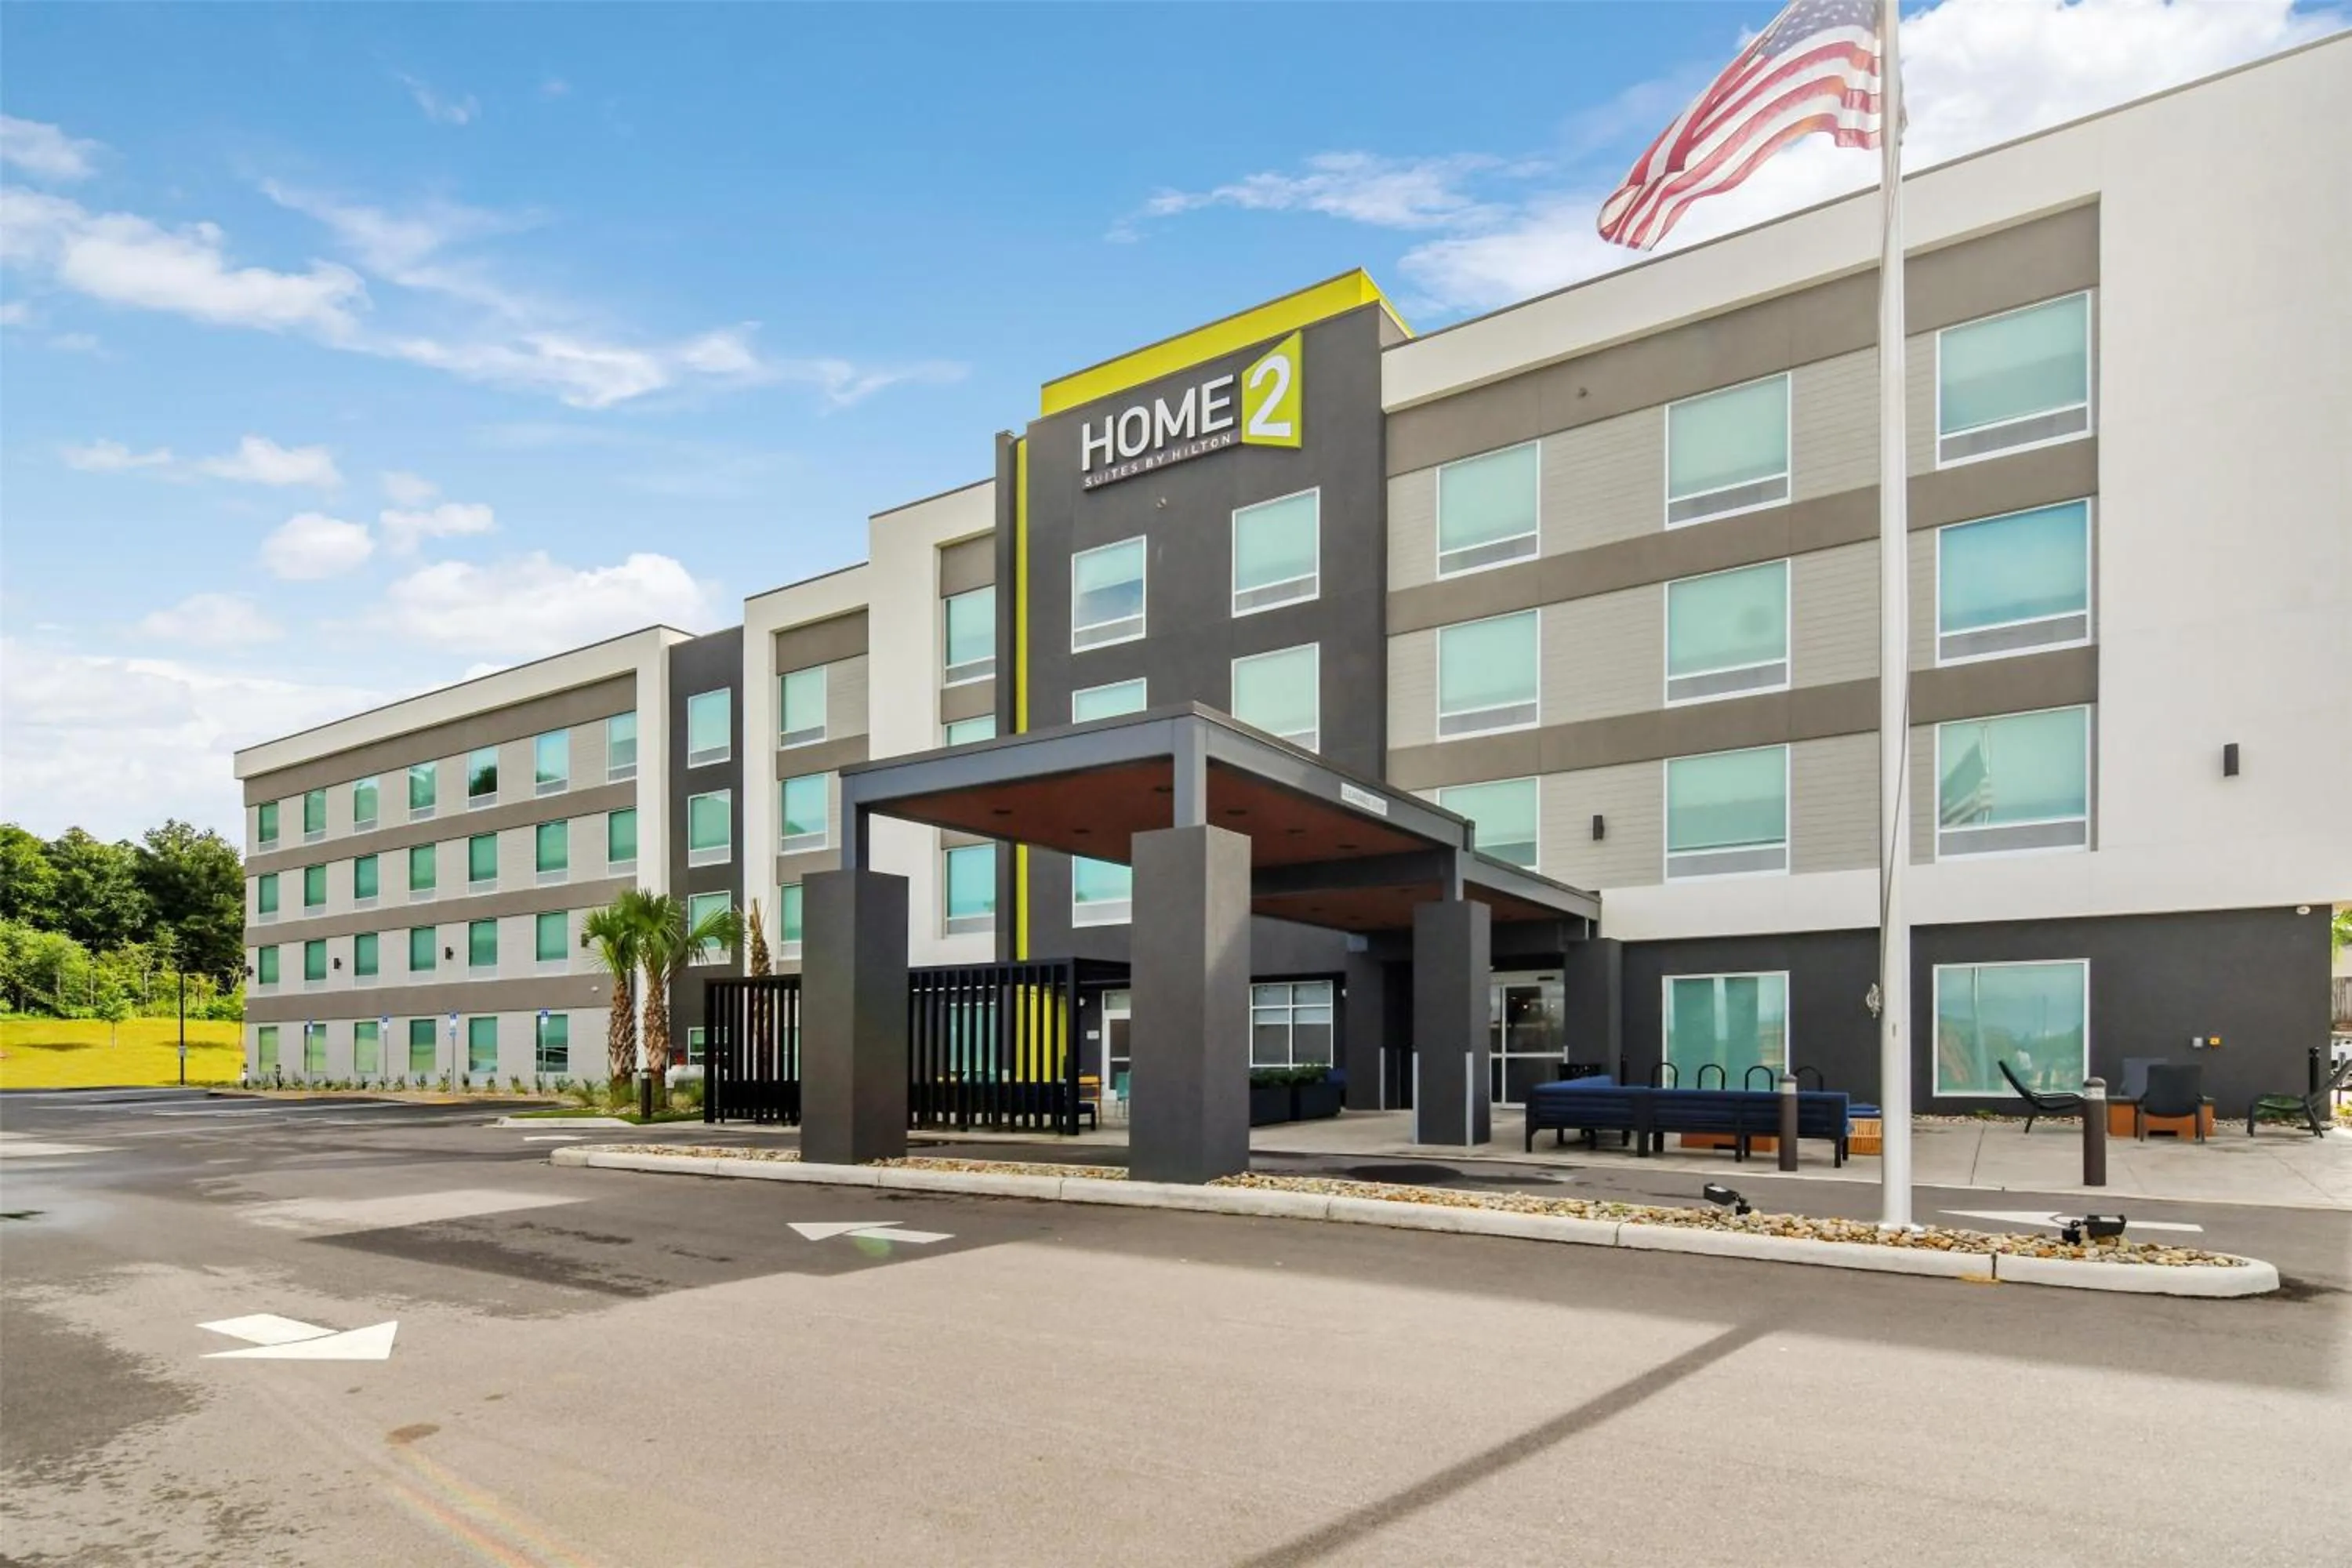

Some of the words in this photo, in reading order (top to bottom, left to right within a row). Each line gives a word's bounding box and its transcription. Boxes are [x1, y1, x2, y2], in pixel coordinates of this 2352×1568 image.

[1082, 374, 1234, 471] HOME
[1248, 354, 1292, 437] 2
[1083, 463, 1138, 487] SUITES
[1145, 452, 1165, 469] BY
[1171, 434, 1232, 461] HILTON
